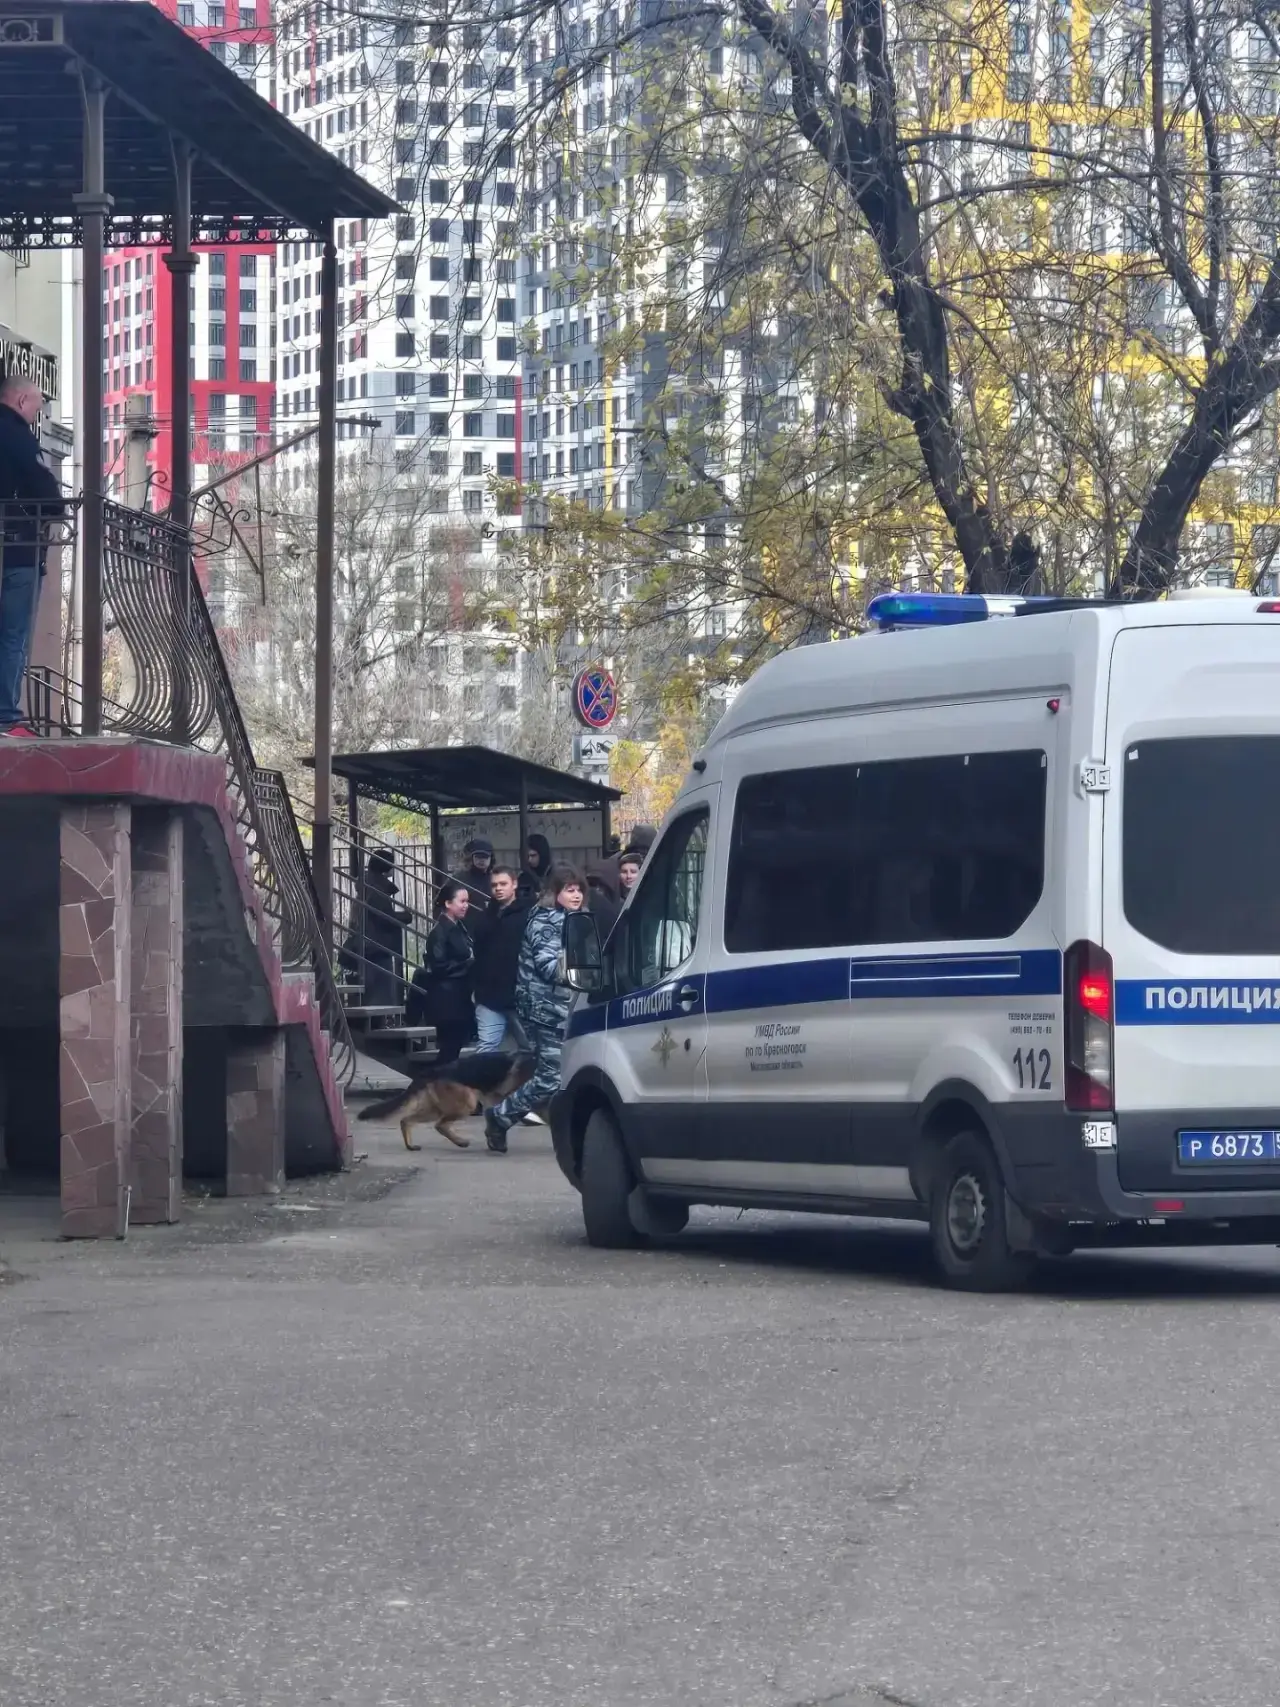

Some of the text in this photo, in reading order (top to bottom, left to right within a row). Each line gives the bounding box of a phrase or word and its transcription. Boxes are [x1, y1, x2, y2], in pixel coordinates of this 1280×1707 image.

[622, 991, 672, 1019] ПОЛИЦИЯ
[754, 1023, 775, 1039] УМВД
[1013, 1047, 1051, 1090] 112
[1211, 1134, 1264, 1157] 6873
